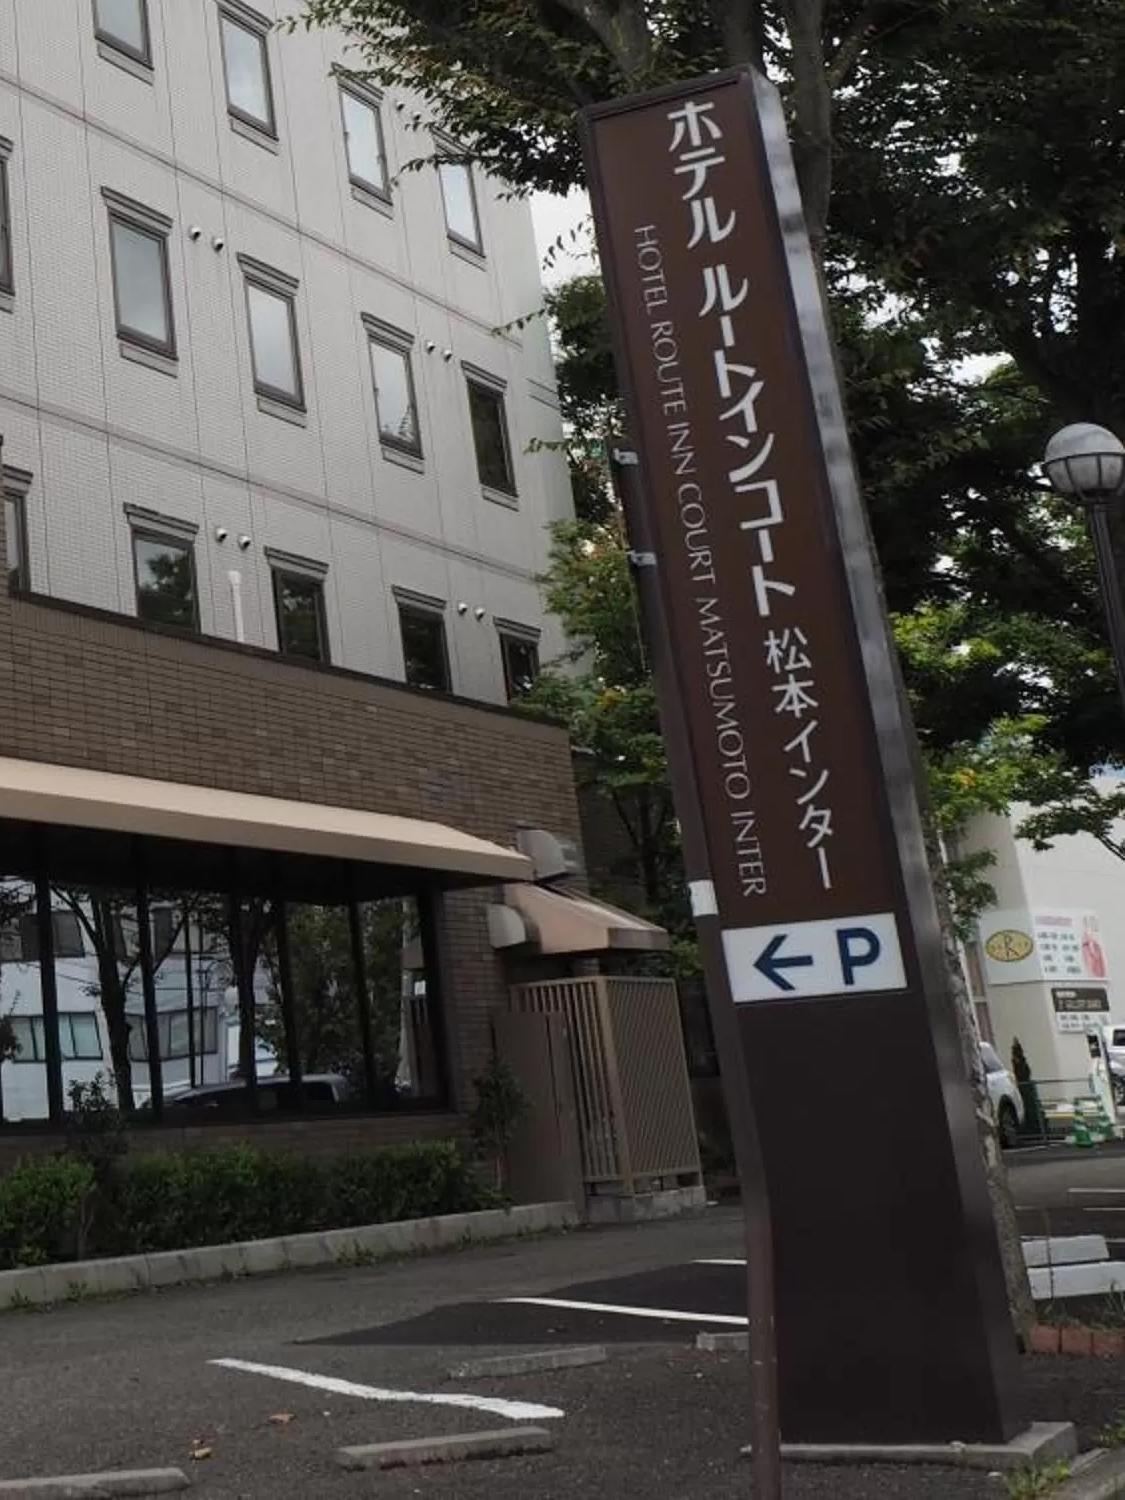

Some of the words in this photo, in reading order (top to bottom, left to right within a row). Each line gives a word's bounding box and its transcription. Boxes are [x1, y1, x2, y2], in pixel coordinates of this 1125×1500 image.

[667, 100, 737, 249] ホテル
[635, 225, 668, 316] HOTEL
[650, 320, 686, 414] ROUTE
[667, 422, 696, 475] INN
[698, 263, 796, 617] ルートインコート
[678, 483, 716, 584] COURT
[696, 597, 751, 800] MATSUMOTO
[763, 627, 833, 890] 松本インター
[730, 810, 768, 898] INTER
[836, 927, 881, 986] P
